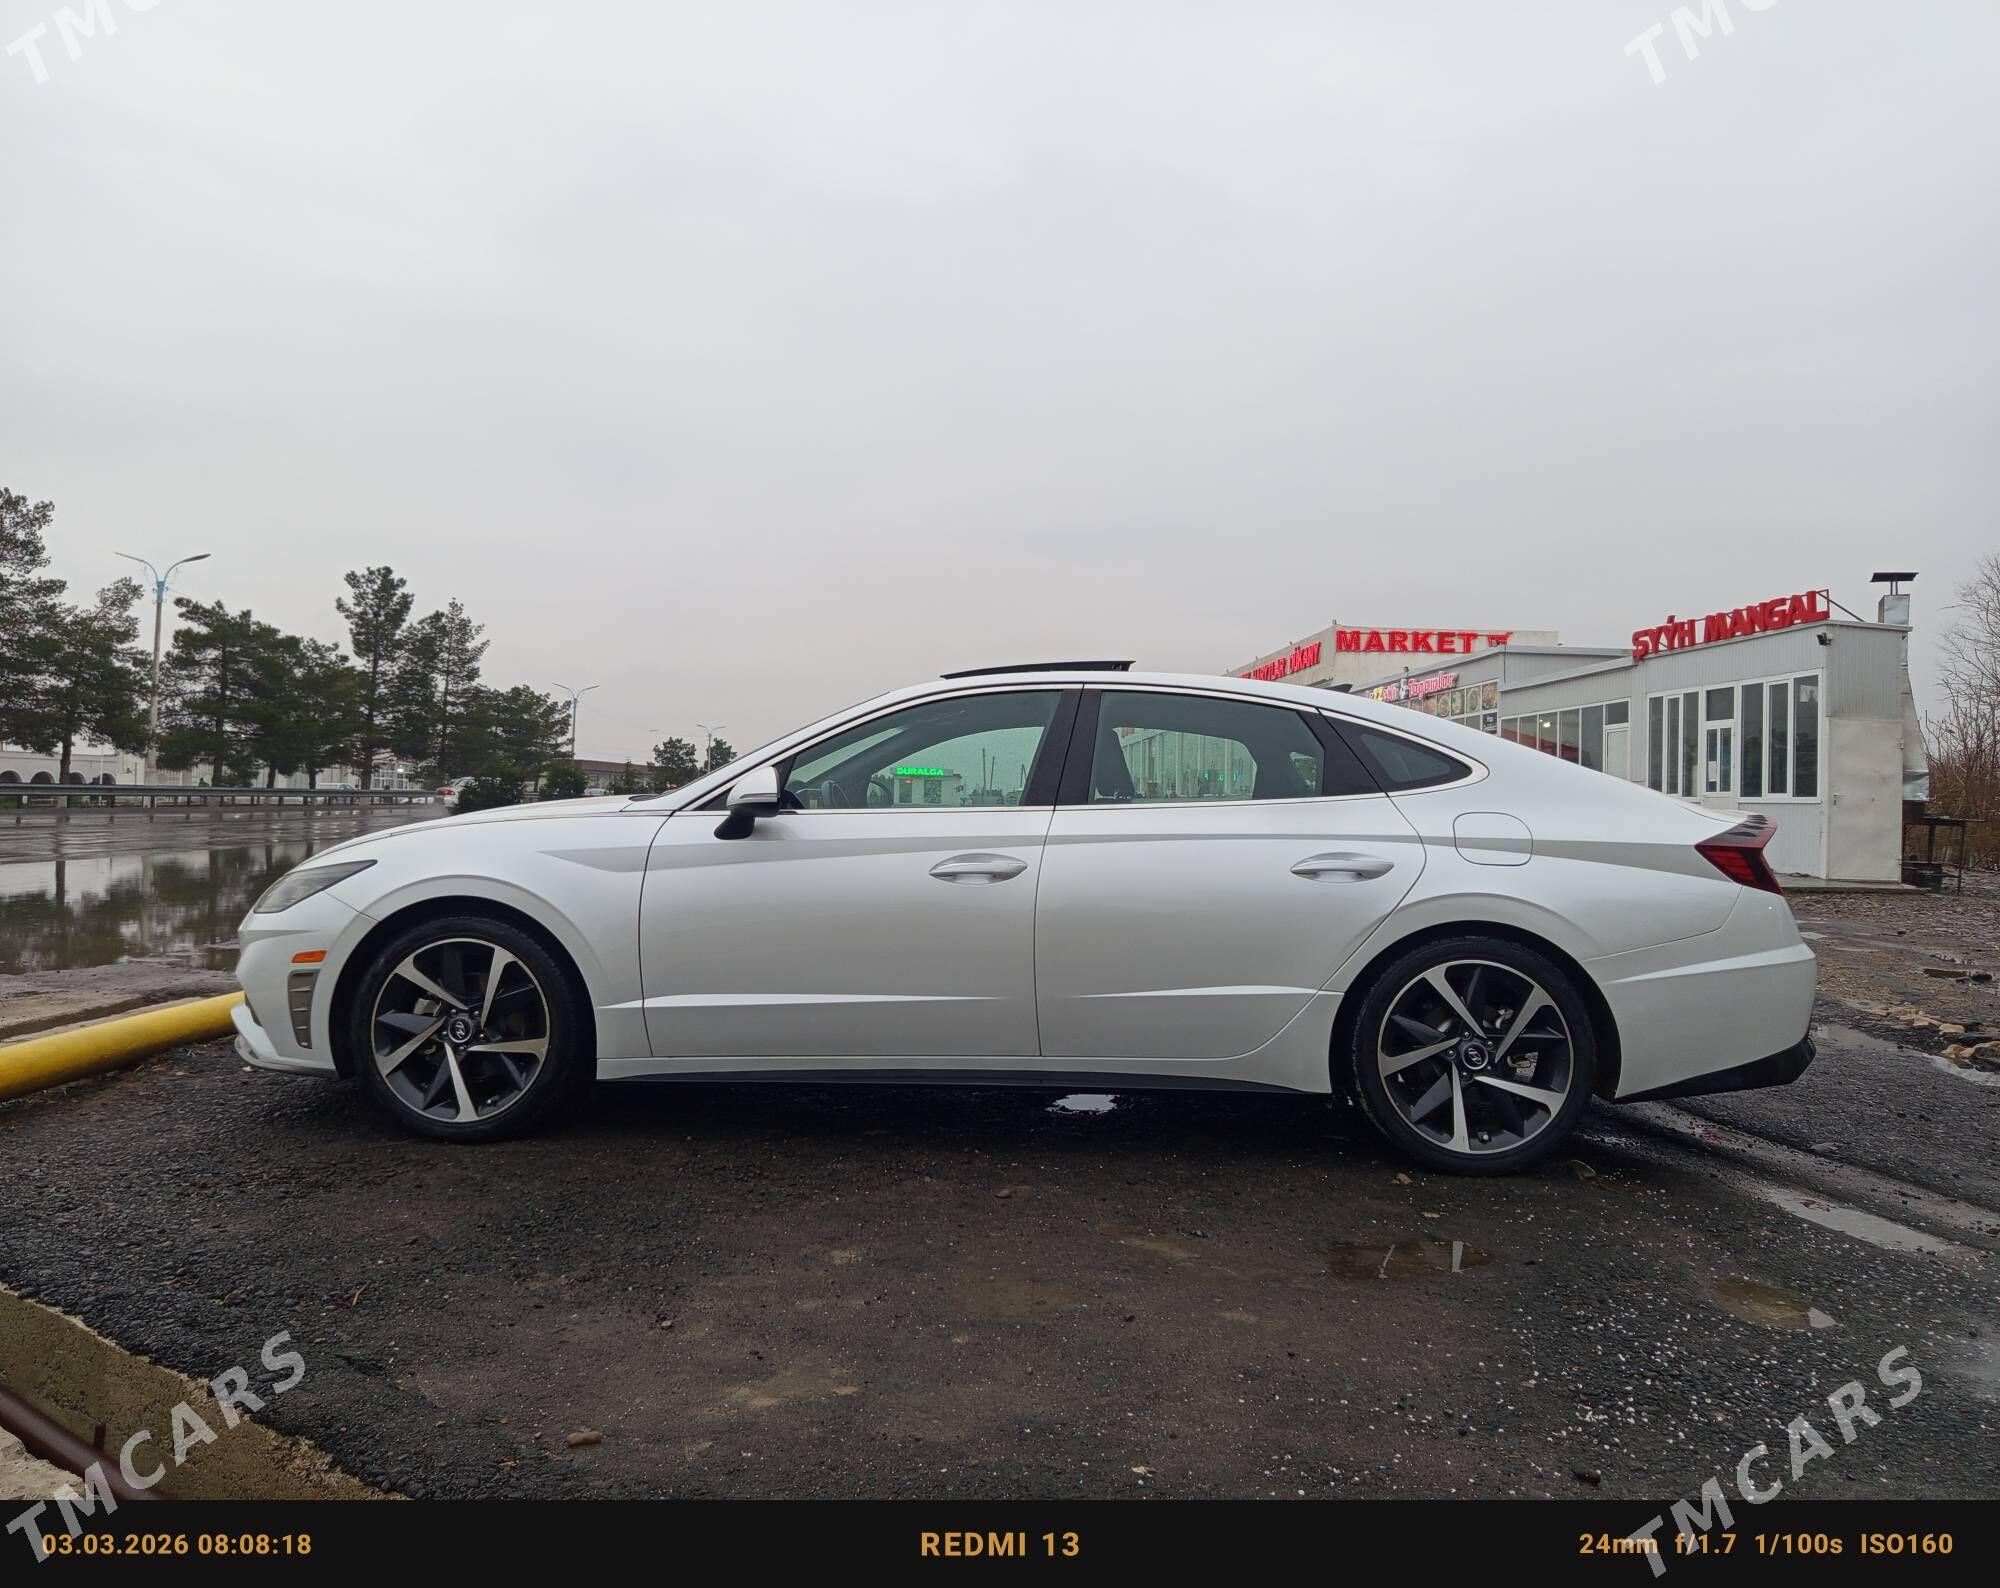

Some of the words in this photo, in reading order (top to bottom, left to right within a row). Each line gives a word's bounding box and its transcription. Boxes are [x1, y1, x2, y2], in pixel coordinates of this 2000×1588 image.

[1704, 591, 1829, 643] MANGAL
[1335, 630, 1478, 653] MARKET
[896, 767, 944, 776] DURALGA
